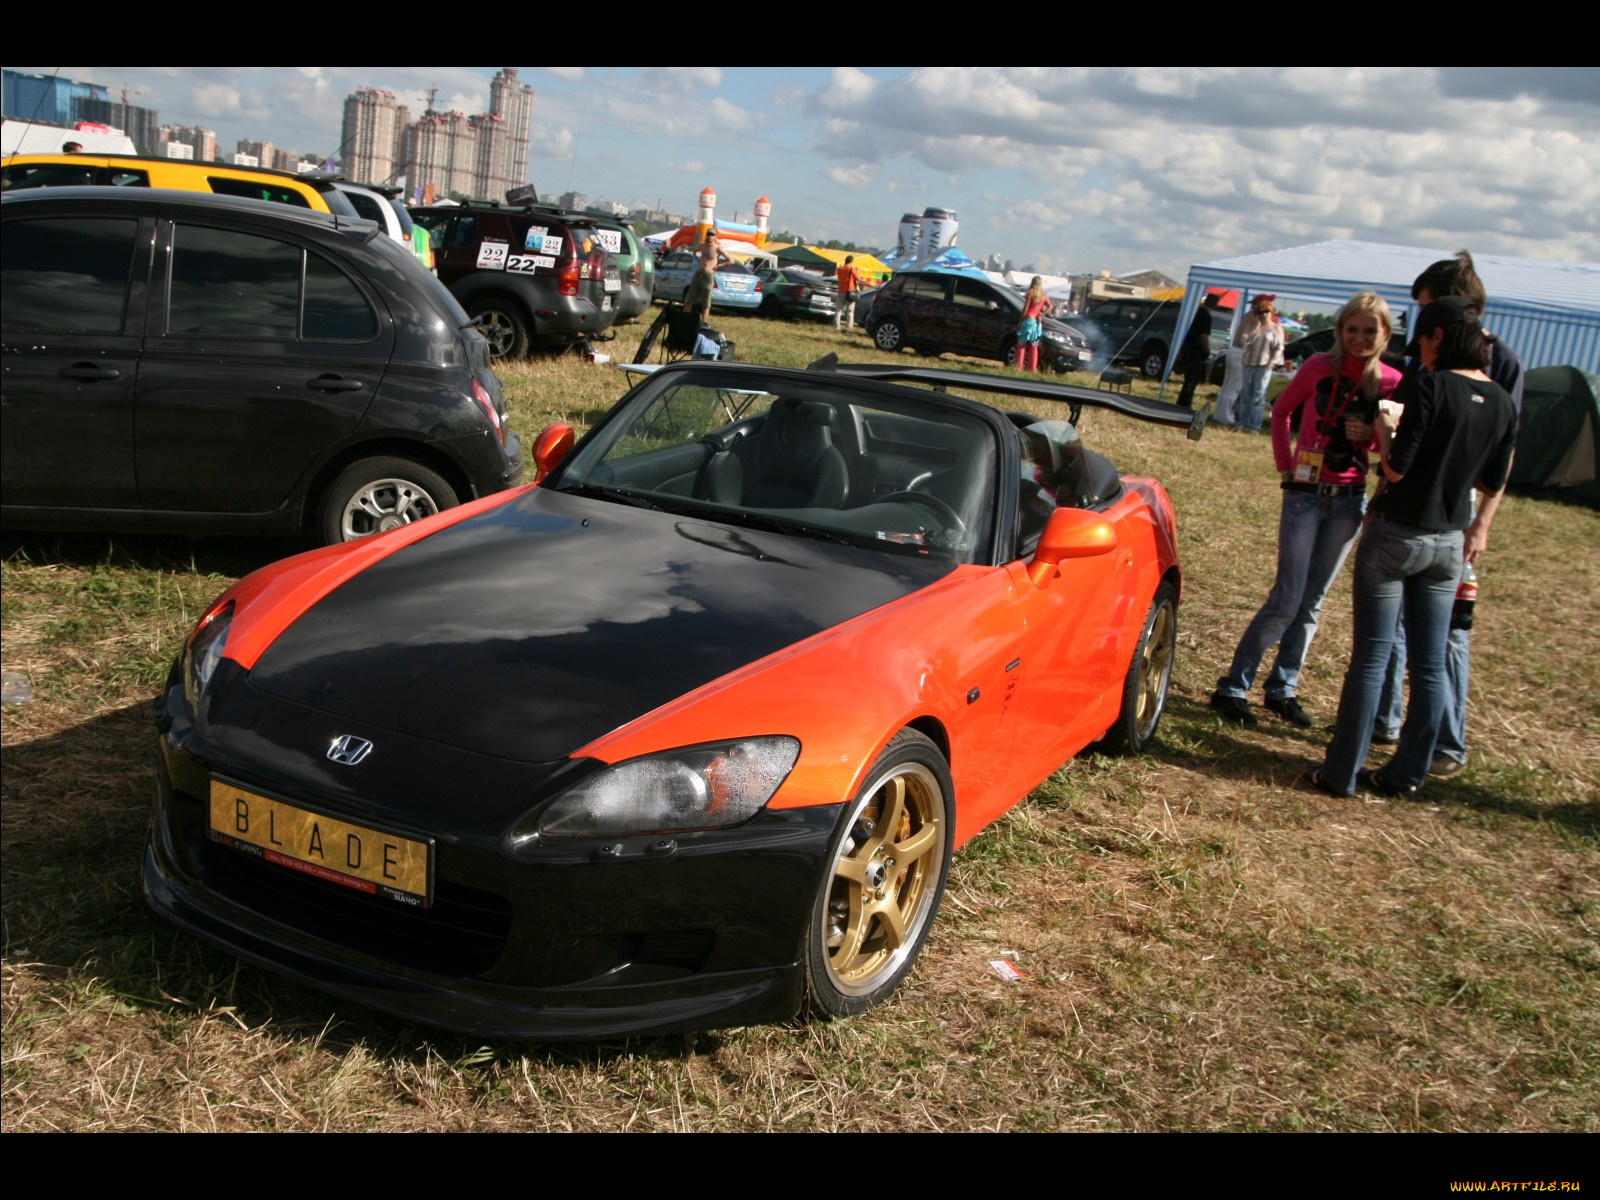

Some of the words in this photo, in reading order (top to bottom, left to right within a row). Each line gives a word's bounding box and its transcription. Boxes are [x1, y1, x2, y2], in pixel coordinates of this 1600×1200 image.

[544, 239, 559, 250] 22
[482, 247, 503, 261] 22
[507, 257, 535, 272] 22
[236, 798, 398, 880] BLADE
